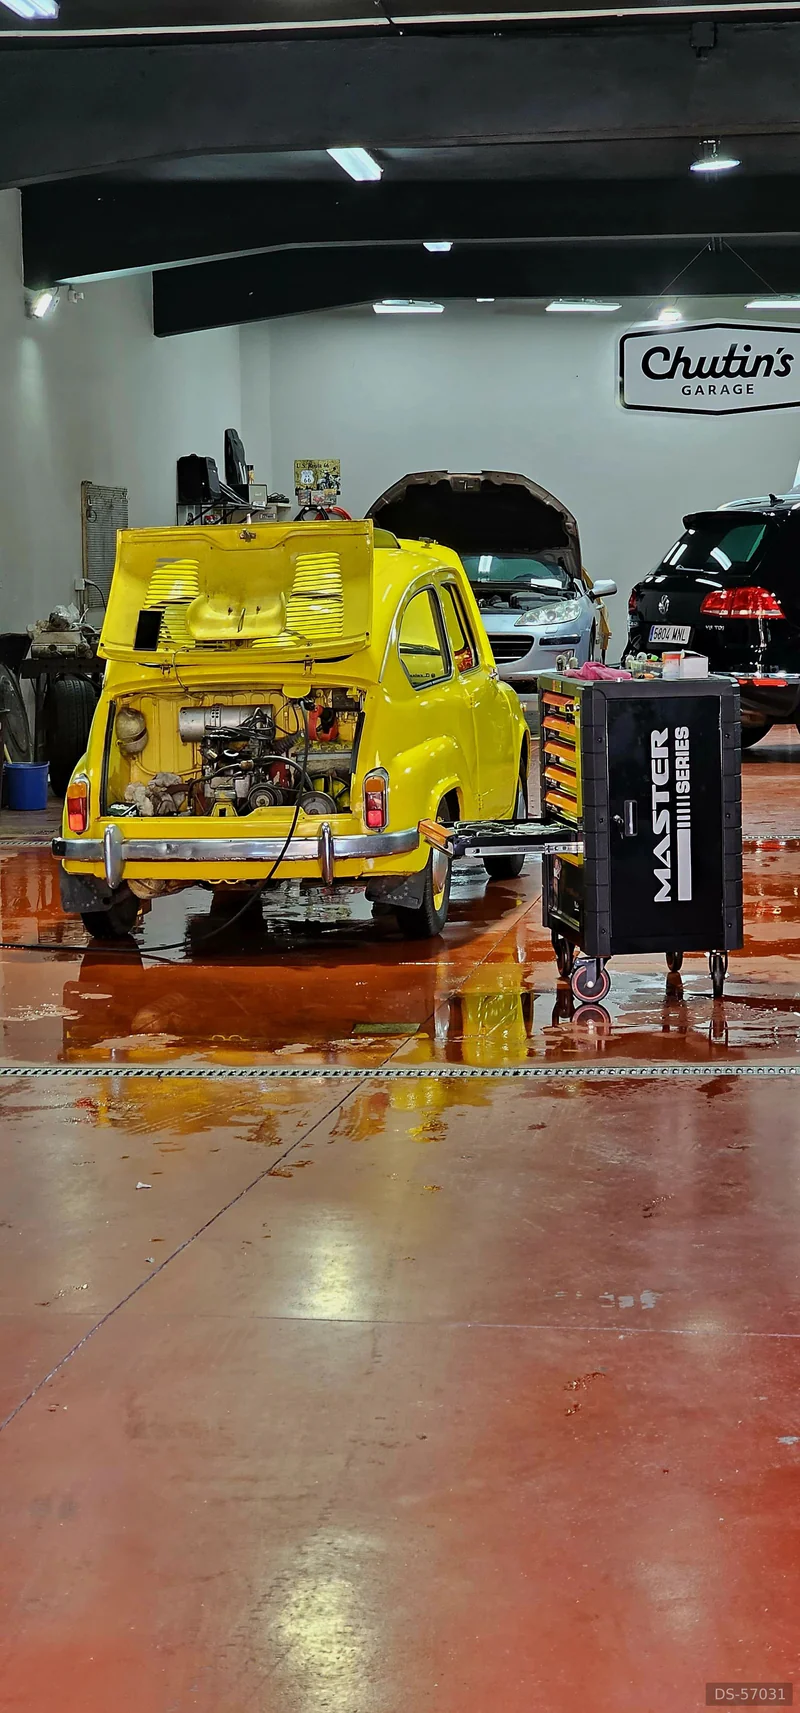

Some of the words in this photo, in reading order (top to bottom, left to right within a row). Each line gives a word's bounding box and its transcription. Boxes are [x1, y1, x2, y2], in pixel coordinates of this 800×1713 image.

[641, 343, 794, 380] Chutin's
[681, 383, 755, 396] GARAGE
[653, 627, 671, 640] 5804
[672, 628, 686, 641] MNL
[675, 726, 690, 793] SERIES
[651, 727, 672, 902] MASTER
